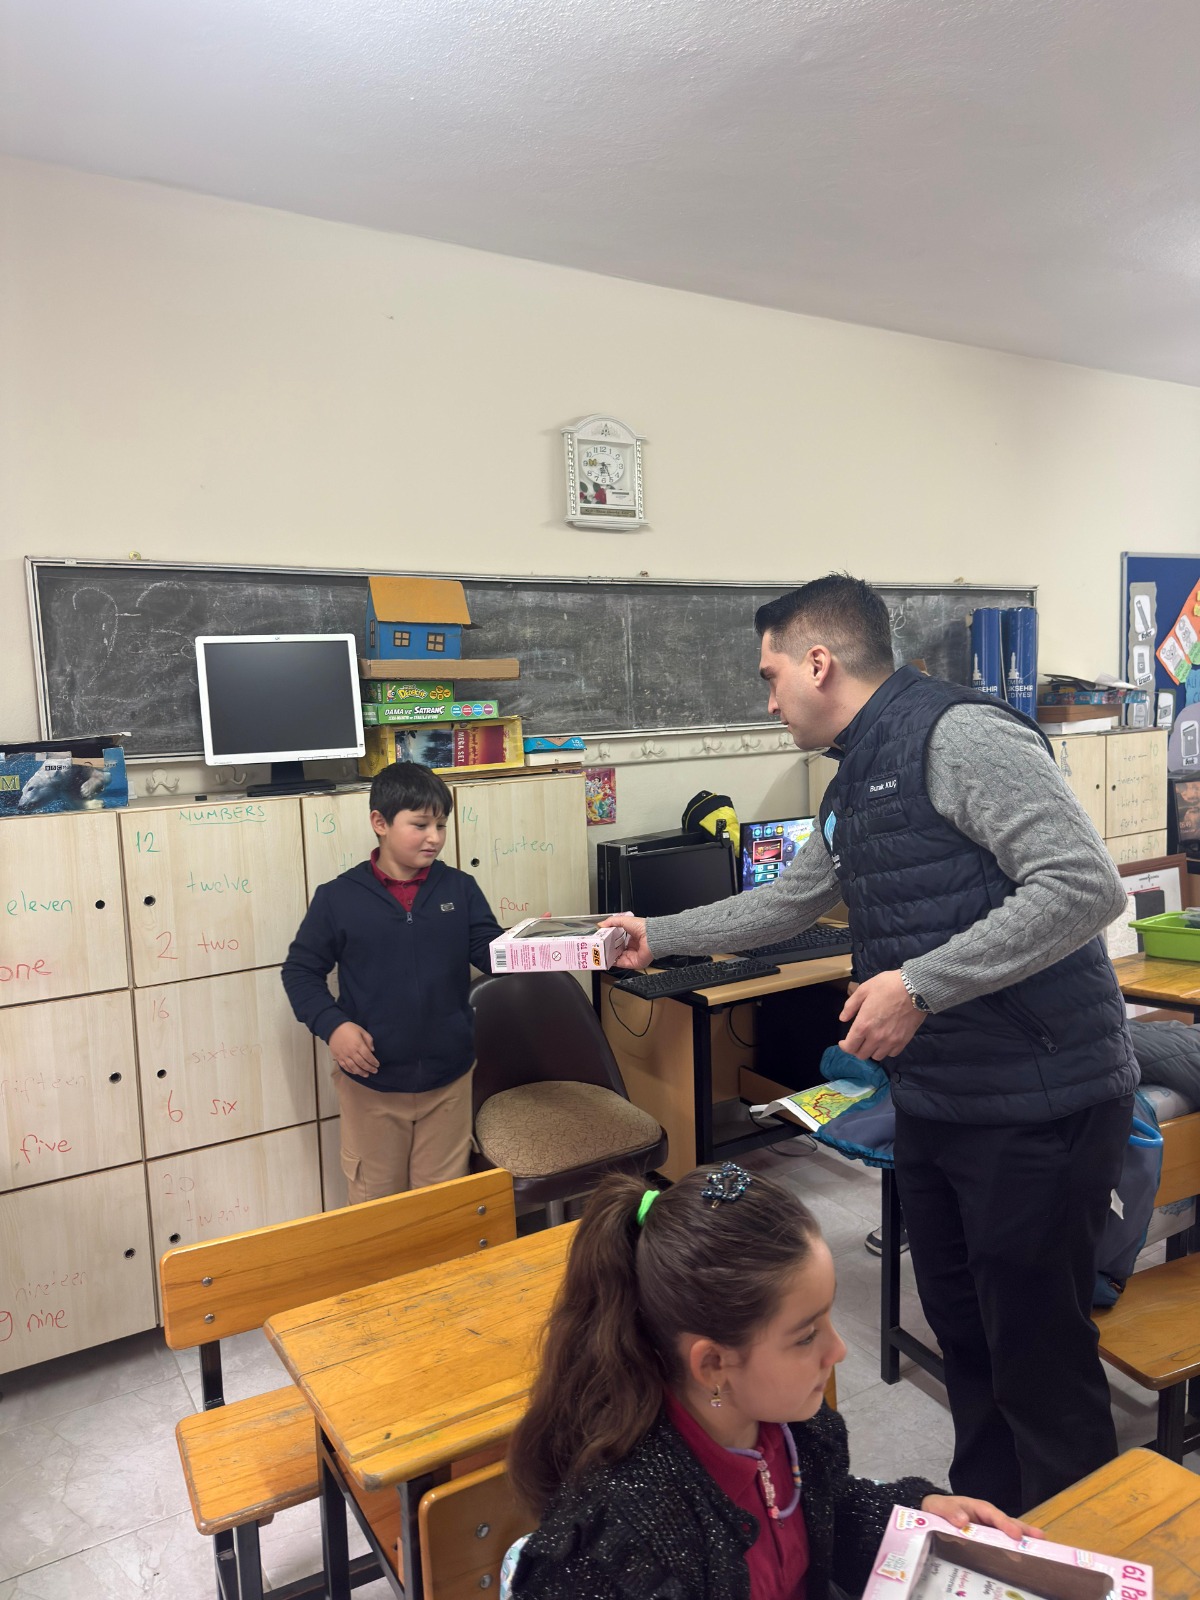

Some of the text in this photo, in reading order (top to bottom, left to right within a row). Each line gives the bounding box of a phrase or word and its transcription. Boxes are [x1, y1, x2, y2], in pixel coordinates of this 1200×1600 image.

[414, 706, 445, 715] SATRANÇ
[179, 804, 265, 821] NUMBERS
[315, 812, 336, 834] 13
[462, 806, 479, 831] 14
[136, 831, 160, 853] 12
[186, 871, 252, 894] twelve
[6, 891, 73, 915] eleven
[499, 896, 530, 921] four
[156, 931, 239, 959] 2 two
[581, 942, 587, 950] 61
[0, 958, 52, 981] one
[153, 997, 170, 1019] 16
[192, 1042, 263, 1064] sixteen
[168, 1090, 238, 1122] 6 six
[20, 1134, 72, 1163] five
[27, 1309, 69, 1332] nine
[1121, 1565, 1147, 1600] 61 Pa
